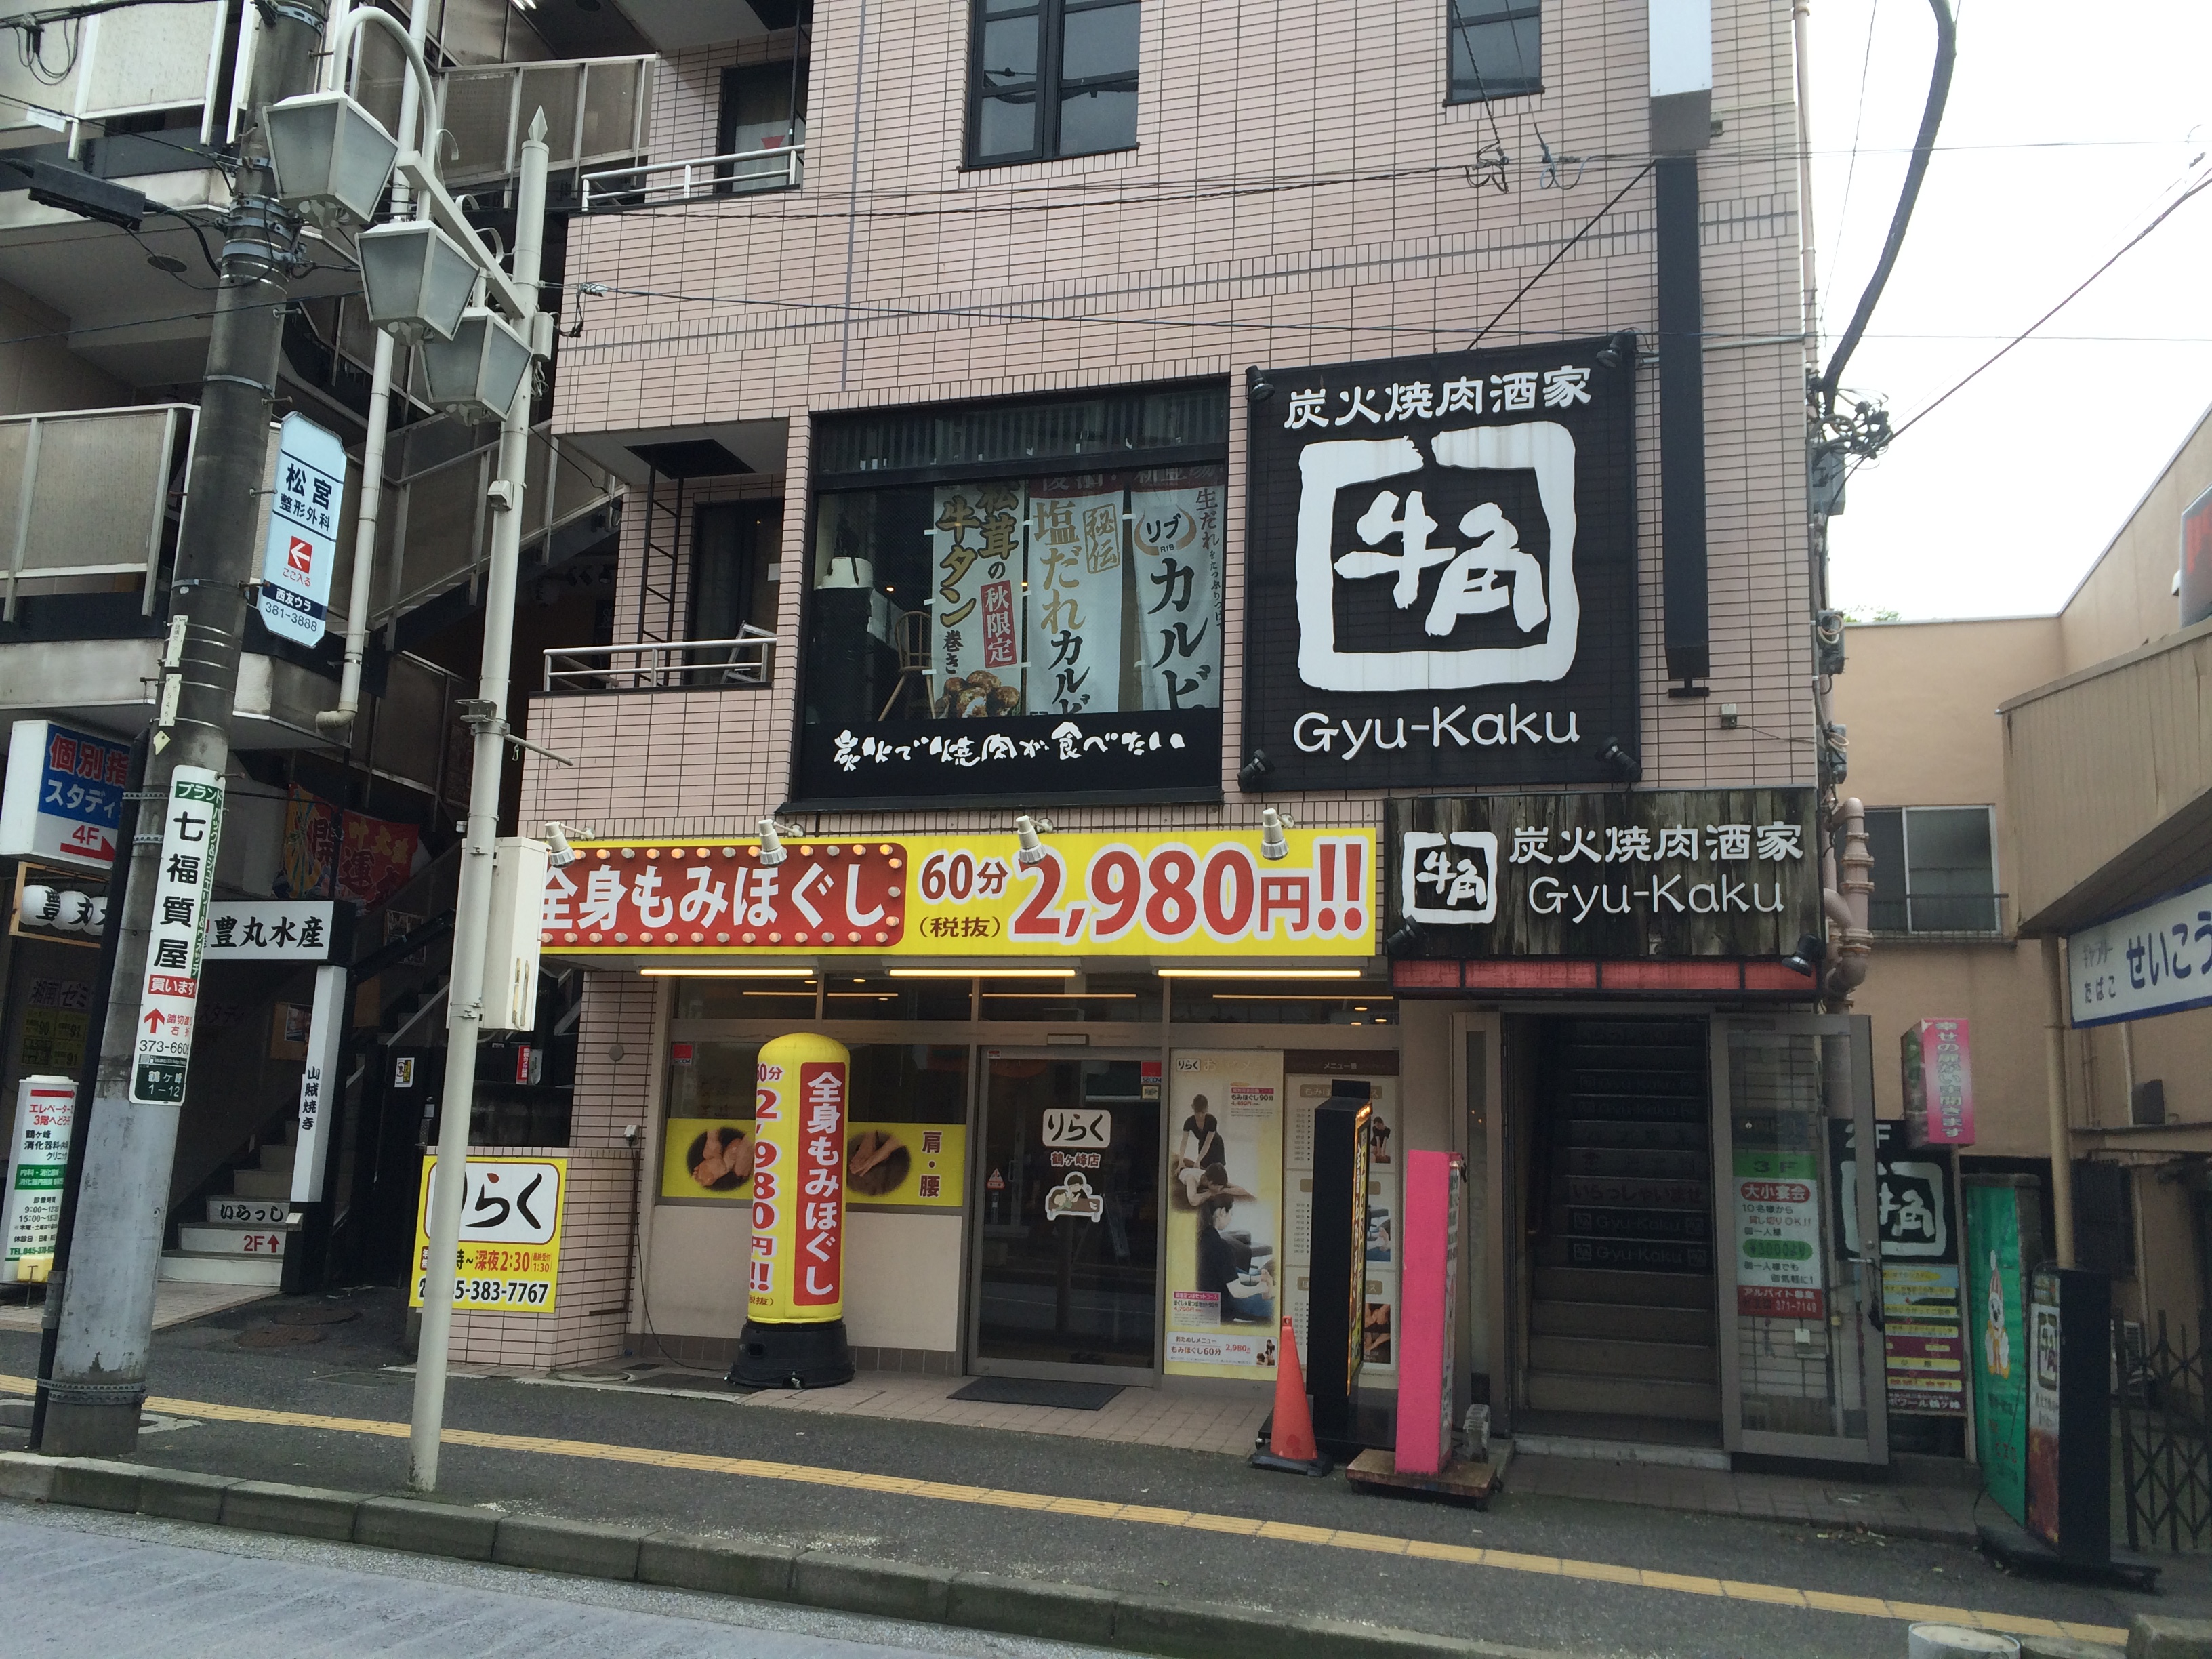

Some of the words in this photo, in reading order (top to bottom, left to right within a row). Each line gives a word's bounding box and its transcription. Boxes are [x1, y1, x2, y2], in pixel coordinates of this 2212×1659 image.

[1284, 365, 1591, 430] 炭火焼肉酒家
[286, 462, 332, 510] 松宮
[279, 493, 330, 532] 整形外科
[975, 483, 1019, 579] 松茸の
[1147, 515, 1181, 544] リブ
[1086, 510, 1120, 571] 秘伝
[1160, 544, 1176, 553] RIB
[283, 568, 311, 587] ここ入る
[935, 495, 980, 674] 牛タン巻き
[265, 602, 317, 632] 381-3888
[276, 588, 311, 612] 西友ウラ
[984, 586, 1013, 665] 秋限定
[1148, 558, 1213, 709] カルビ
[1294, 703, 1580, 760] Gyu-Kaku
[45, 779, 116, 819] スタディ
[178, 783, 222, 802] ブランド
[72, 825, 100, 845] 4F
[1509, 821, 1803, 865] 炭火焼肉酒家
[154, 811, 206, 970] 七福質屋
[542, 862, 886, 930] 全身もみほぐし
[922, 853, 1008, 900] 60分
[1014, 844, 1364, 938] 2,980円!!
[1529, 874, 1785, 924] Gyu-Kaku
[210, 916, 324, 948] 豊丸水産
[920, 916, 1001, 939] （税抜）
[1179, 1060, 1200, 1070] りらく
[148, 1084, 180, 1098] 1-12
[302, 1066, 321, 1130] 山賊焼き
[1048, 1113, 1104, 1141] りらく
[918, 1131, 942, 1197] 肩・腰
[1051, 1151, 1101, 1168] 鶴ヶ峰店
[804, 1071, 842, 1296] 全身もみほぐし
[1745, 1185, 1806, 1200] 大小宴会
[243, 1235, 264, 1252] 2F
[533, 1263, 550, 1273] 1:30
[1171, 1346, 1221, 1356] もみほぐし60分
